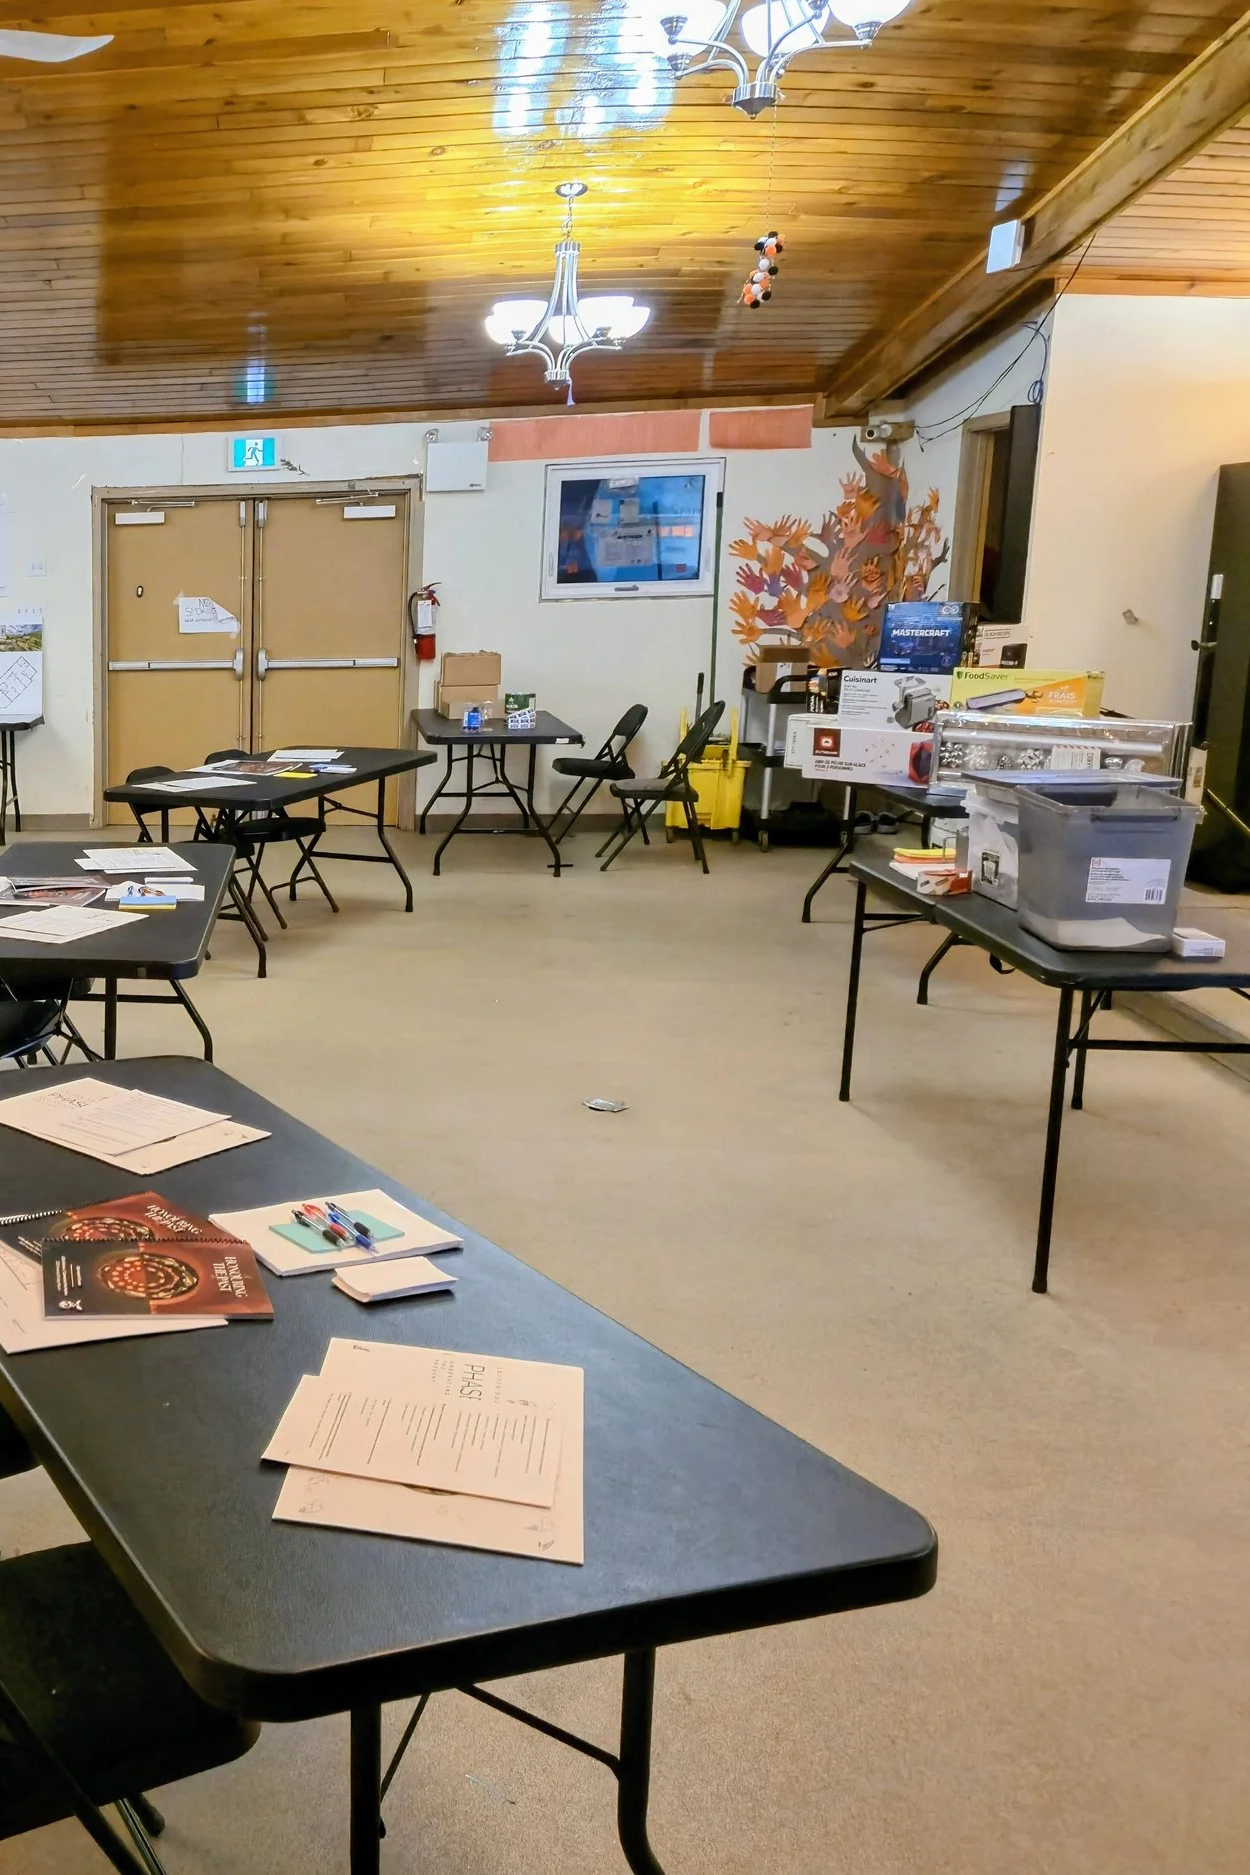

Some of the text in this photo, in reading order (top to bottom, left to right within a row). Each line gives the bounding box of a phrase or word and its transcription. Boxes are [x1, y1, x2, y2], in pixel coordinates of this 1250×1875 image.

[198, 598, 210, 608] NO
[892, 628, 951, 637] MASTERCRAFT
[843, 674, 878, 684] Cuisinart
[964, 671, 1010, 681] FoodSaver
[1049, 691, 1076, 700] FRAIS
[212, 1262, 232, 1292] THE PAST
[224, 1256, 248, 1298] HONOURING
